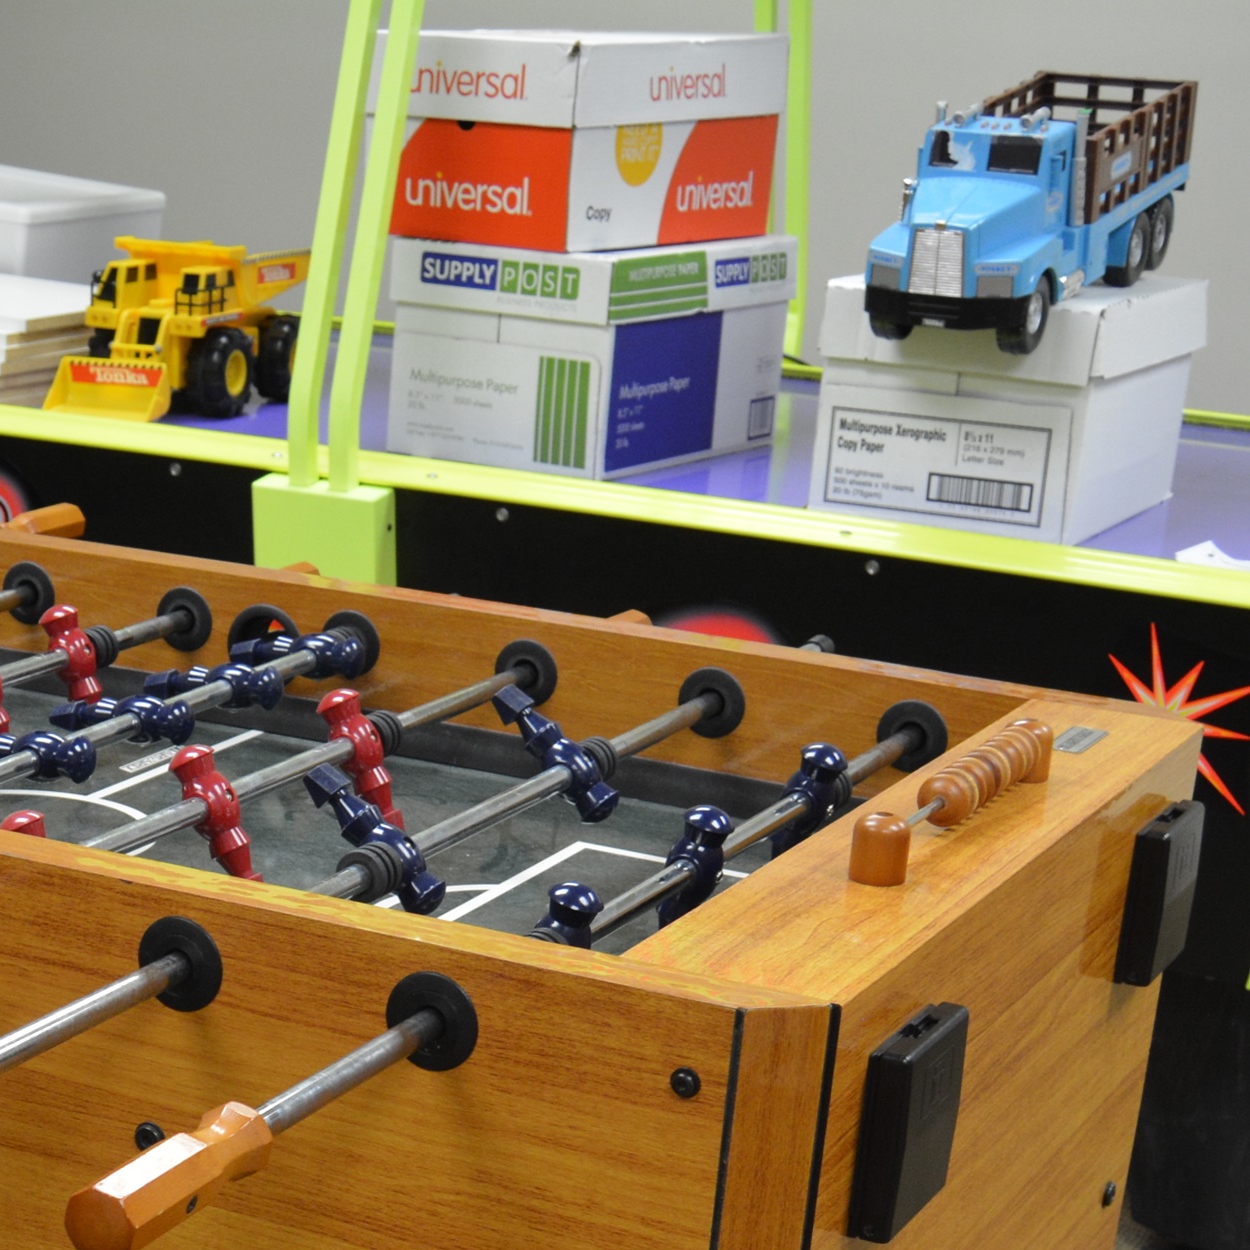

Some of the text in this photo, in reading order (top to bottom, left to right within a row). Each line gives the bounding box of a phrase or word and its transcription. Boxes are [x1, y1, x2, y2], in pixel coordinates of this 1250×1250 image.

[650, 63, 726, 101] universal
[405, 171, 530, 216] universal
[676, 170, 754, 212] universal
[586, 206, 612, 222] Copy
[423, 258, 578, 294] SUPPLY POST
[716, 261, 750, 284] SUPPLY
[752, 257, 787, 281] POST
[89, 366, 149, 386] Tonka
[410, 368, 519, 396] Multipurpose Paper
[619, 376, 691, 401] Multipurpose Paper
[839, 418, 947, 442] Multipurpose Xerographic
[985, 433, 994, 444] 11
[837, 436, 885, 454] Copy Paper
[962, 454, 1005, 466] Letter Size
